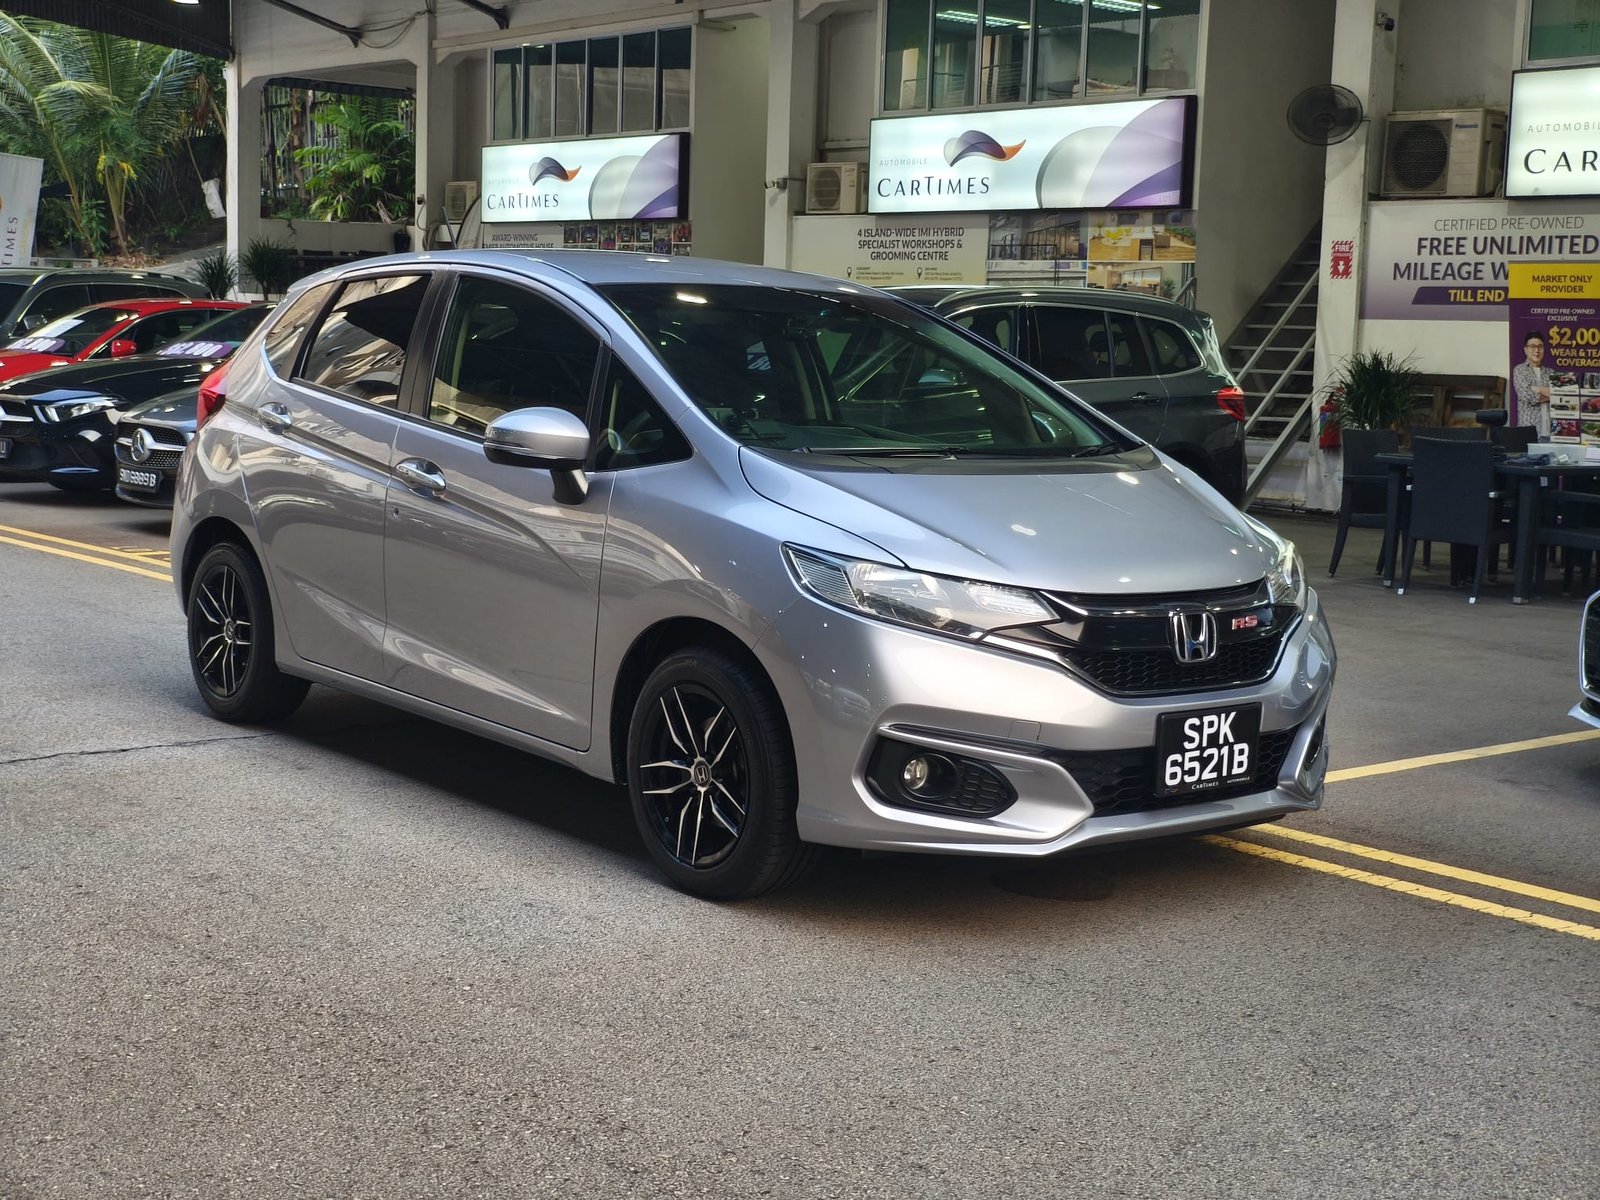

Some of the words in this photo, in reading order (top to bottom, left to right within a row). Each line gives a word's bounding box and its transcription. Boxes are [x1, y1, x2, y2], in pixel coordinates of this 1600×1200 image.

[1528, 121, 1600, 133] AUTOMOBIL
[1523, 148, 1600, 175] CAR
[1434, 218, 1497, 232] CERTIFIED
[1501, 216, 1585, 230] PRE-OWNED
[492, 233, 539, 242] AWARD-WINNING
[857, 229, 862, 237] 4
[863, 228, 917, 237] ISLAND-WIDE
[918, 228, 931, 237] IMI
[933, 227, 965, 237] HYBRID
[858, 239, 900, 249] SPECIALIST
[901, 239, 954, 249] WORKSHOPS
[956, 240, 963, 248] &
[1335, 244, 1350, 252] FIRE
[1416, 236, 1468, 256] FREE
[1472, 234, 1599, 256] UNLIMITED
[870, 251, 916, 260] GROOMING
[917, 251, 949, 260] CENTRE
[1393, 262, 1485, 281] MILEAGE
[1491, 261, 1509, 280] W
[1532, 275, 1567, 283] MARKET
[1569, 275, 1592, 283] ONLY
[1448, 289, 1474, 302] TILL
[1476, 289, 1504, 302] END
[1548, 325, 1600, 347] $2,00
[1550, 348, 1577, 357] WEAR
[1578, 348, 1586, 357] &
[1587, 348, 1600, 357] TEA
[1231, 615, 1258, 630] RS
[1183, 711, 1237, 750] SPK
[1164, 742, 1250, 787] 6521B
